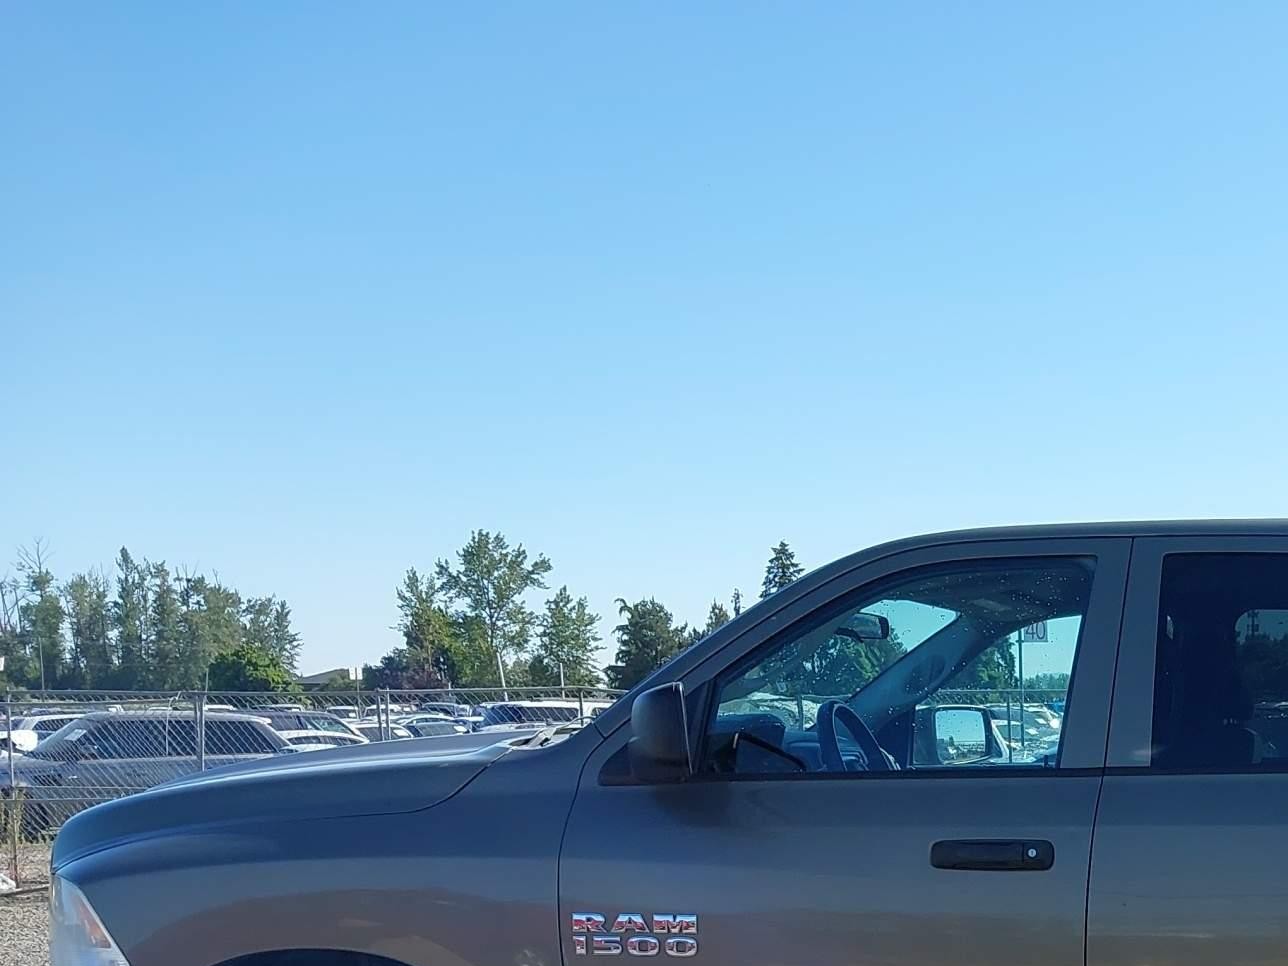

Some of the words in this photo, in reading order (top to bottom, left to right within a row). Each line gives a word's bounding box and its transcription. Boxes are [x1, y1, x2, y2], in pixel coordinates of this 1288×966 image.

[1025, 621, 1046, 640] 40
[571, 912, 698, 934] RAM
[572, 935, 698, 957] 1500
